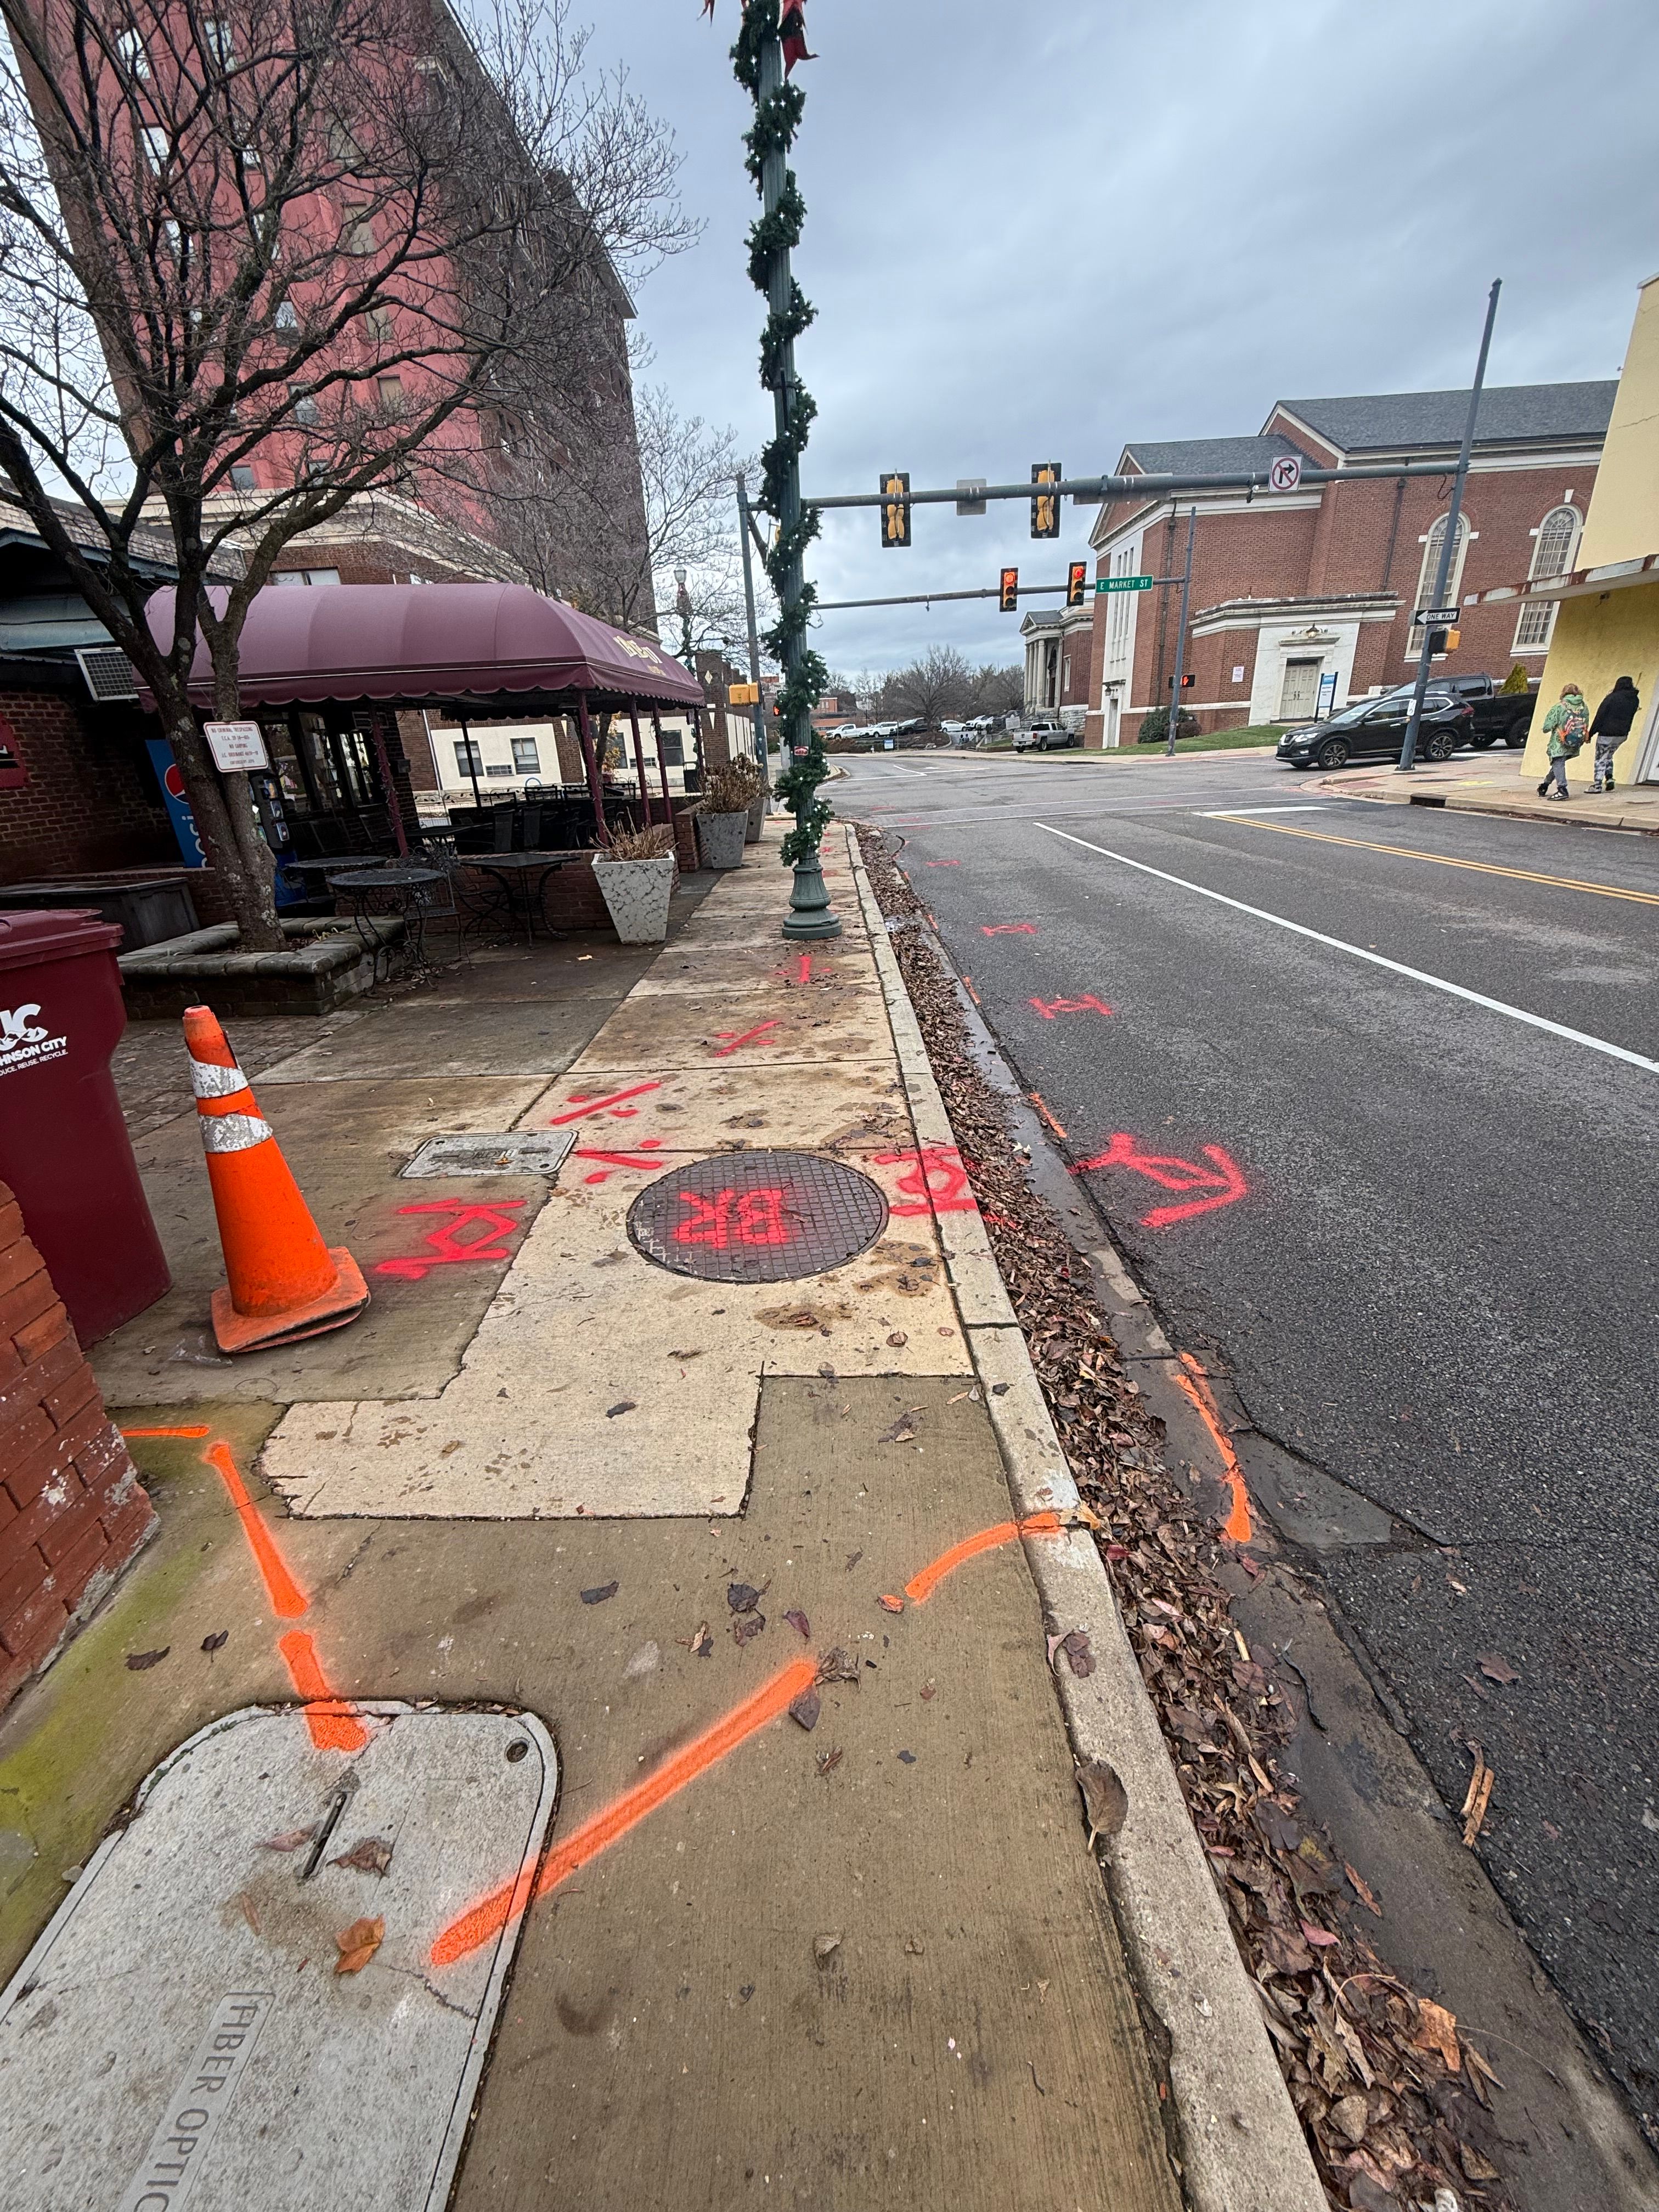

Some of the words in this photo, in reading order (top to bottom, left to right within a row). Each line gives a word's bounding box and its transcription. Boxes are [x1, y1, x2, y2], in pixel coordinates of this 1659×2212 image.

[1109, 580, 1135, 589] MARKET
[1139, 579, 1148, 588] ST
[0, 1044, 41, 1066] HNSON
[41, 1036, 67, 1052] CITY
[189, 2005, 258, 2094] FIBER
